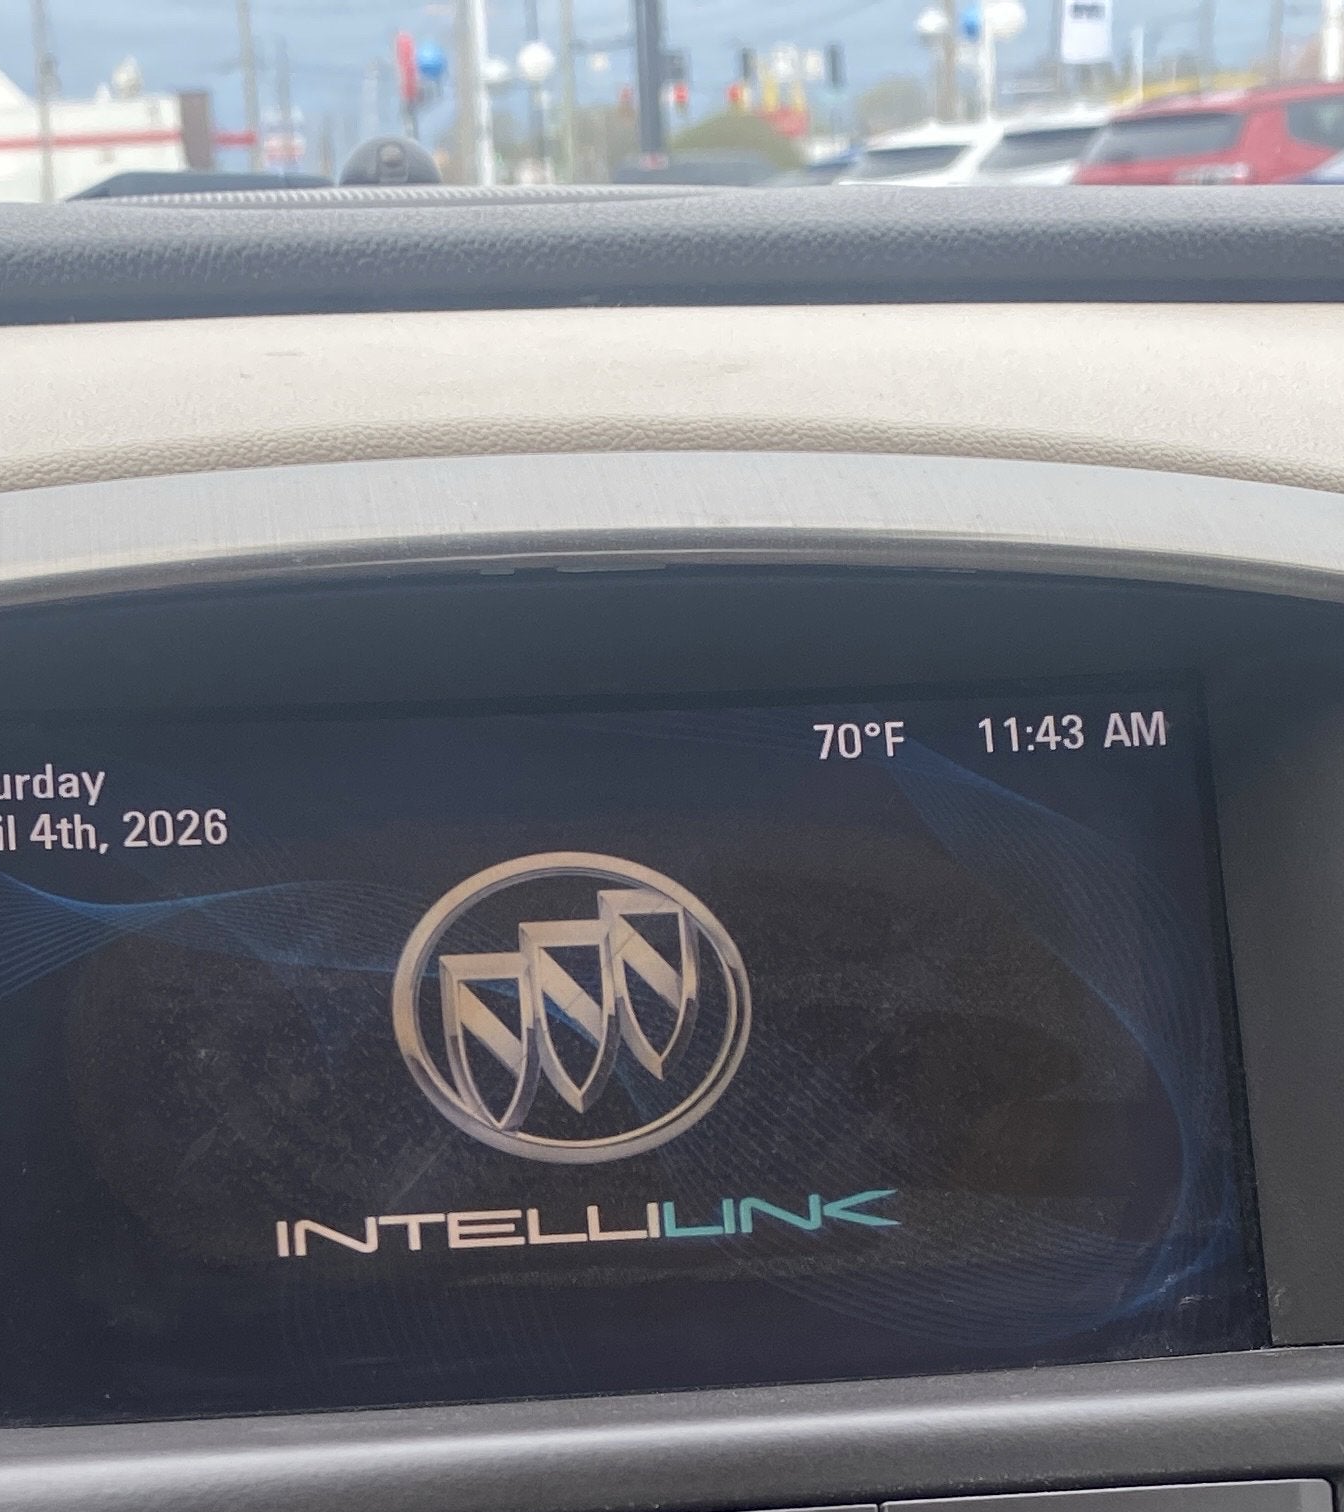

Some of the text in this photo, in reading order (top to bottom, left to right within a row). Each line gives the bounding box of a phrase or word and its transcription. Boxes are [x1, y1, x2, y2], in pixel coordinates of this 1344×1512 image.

[812, 721, 905, 760] 70°F
[978, 710, 1167, 753] 11:43 AM
[29, 813, 109, 855] 4th,
[122, 808, 228, 848] 2026
[275, 1188, 902, 1259] INTELLILINK
